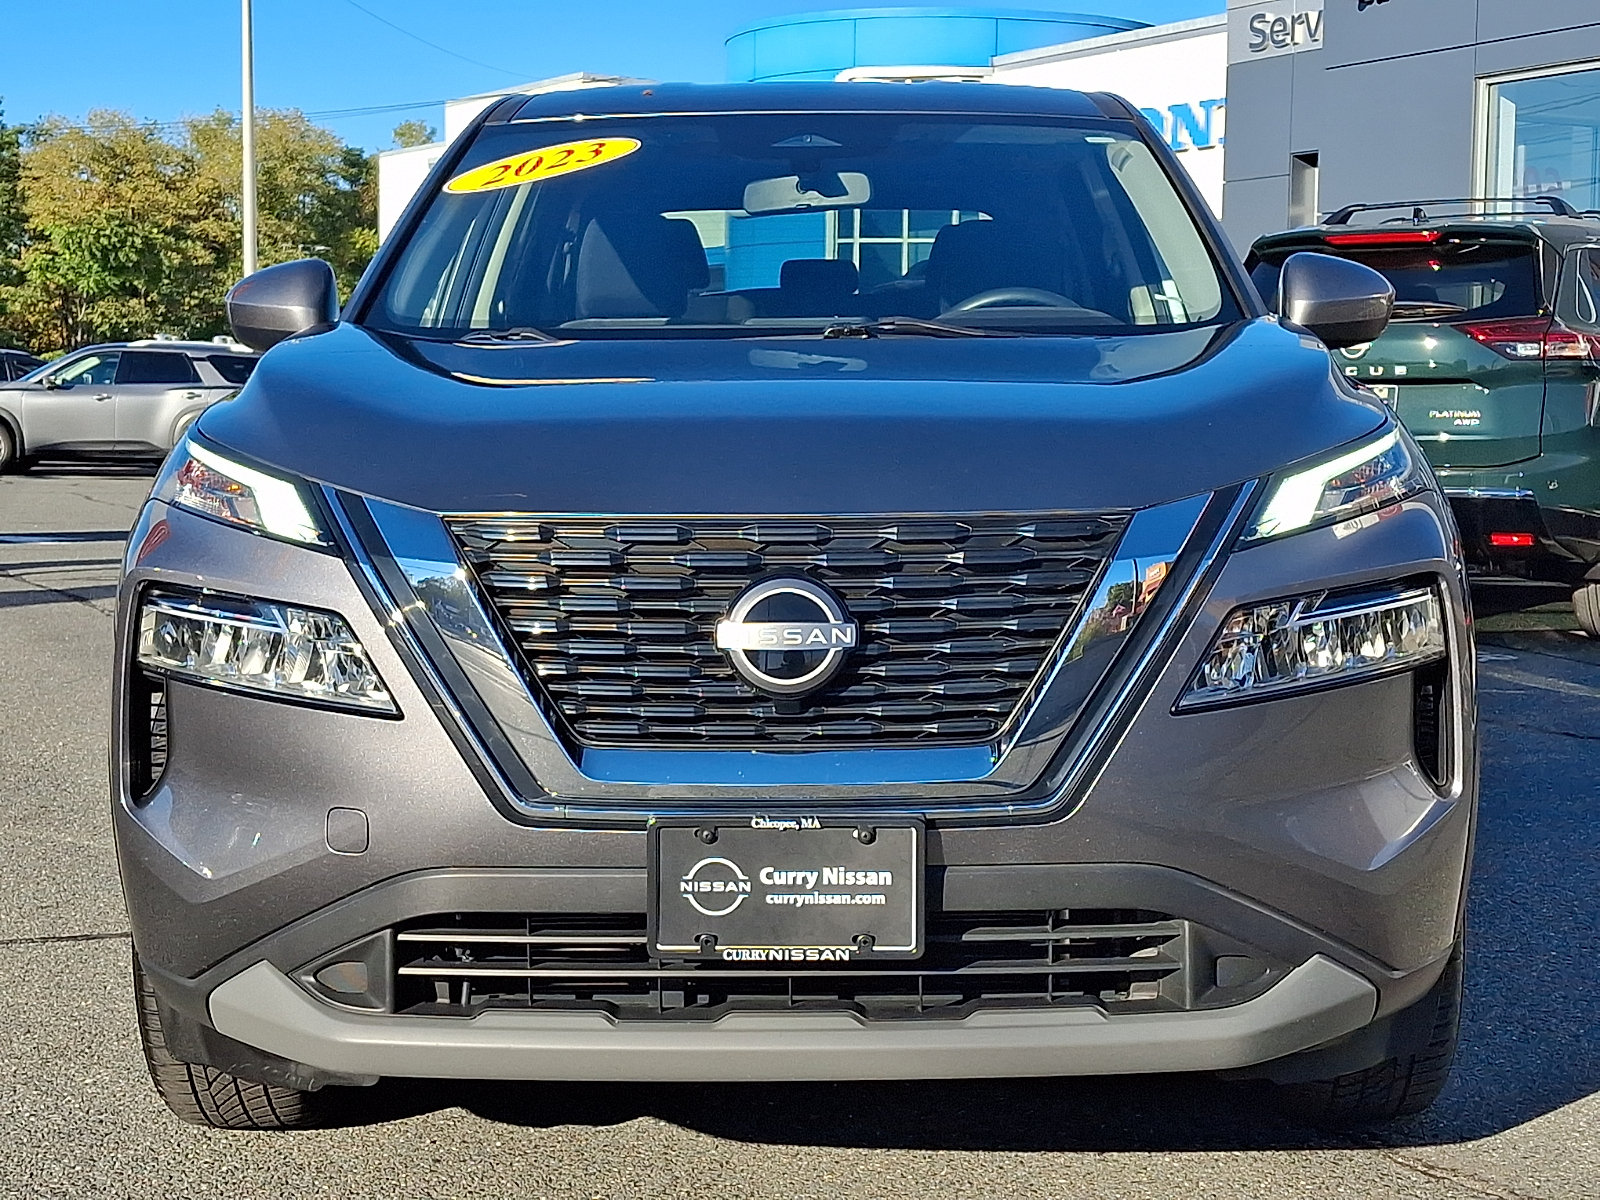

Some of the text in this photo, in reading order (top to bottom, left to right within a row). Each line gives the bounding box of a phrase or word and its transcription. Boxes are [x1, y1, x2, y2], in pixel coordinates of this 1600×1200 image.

[481, 143, 606, 187] 2023
[1453, 418, 1480, 426] AWD
[801, 816, 821, 829] MA
[759, 867, 893, 889] Curry Nissan
[680, 881, 752, 893] NISSAN
[765, 891, 886, 908] currynissan.com
